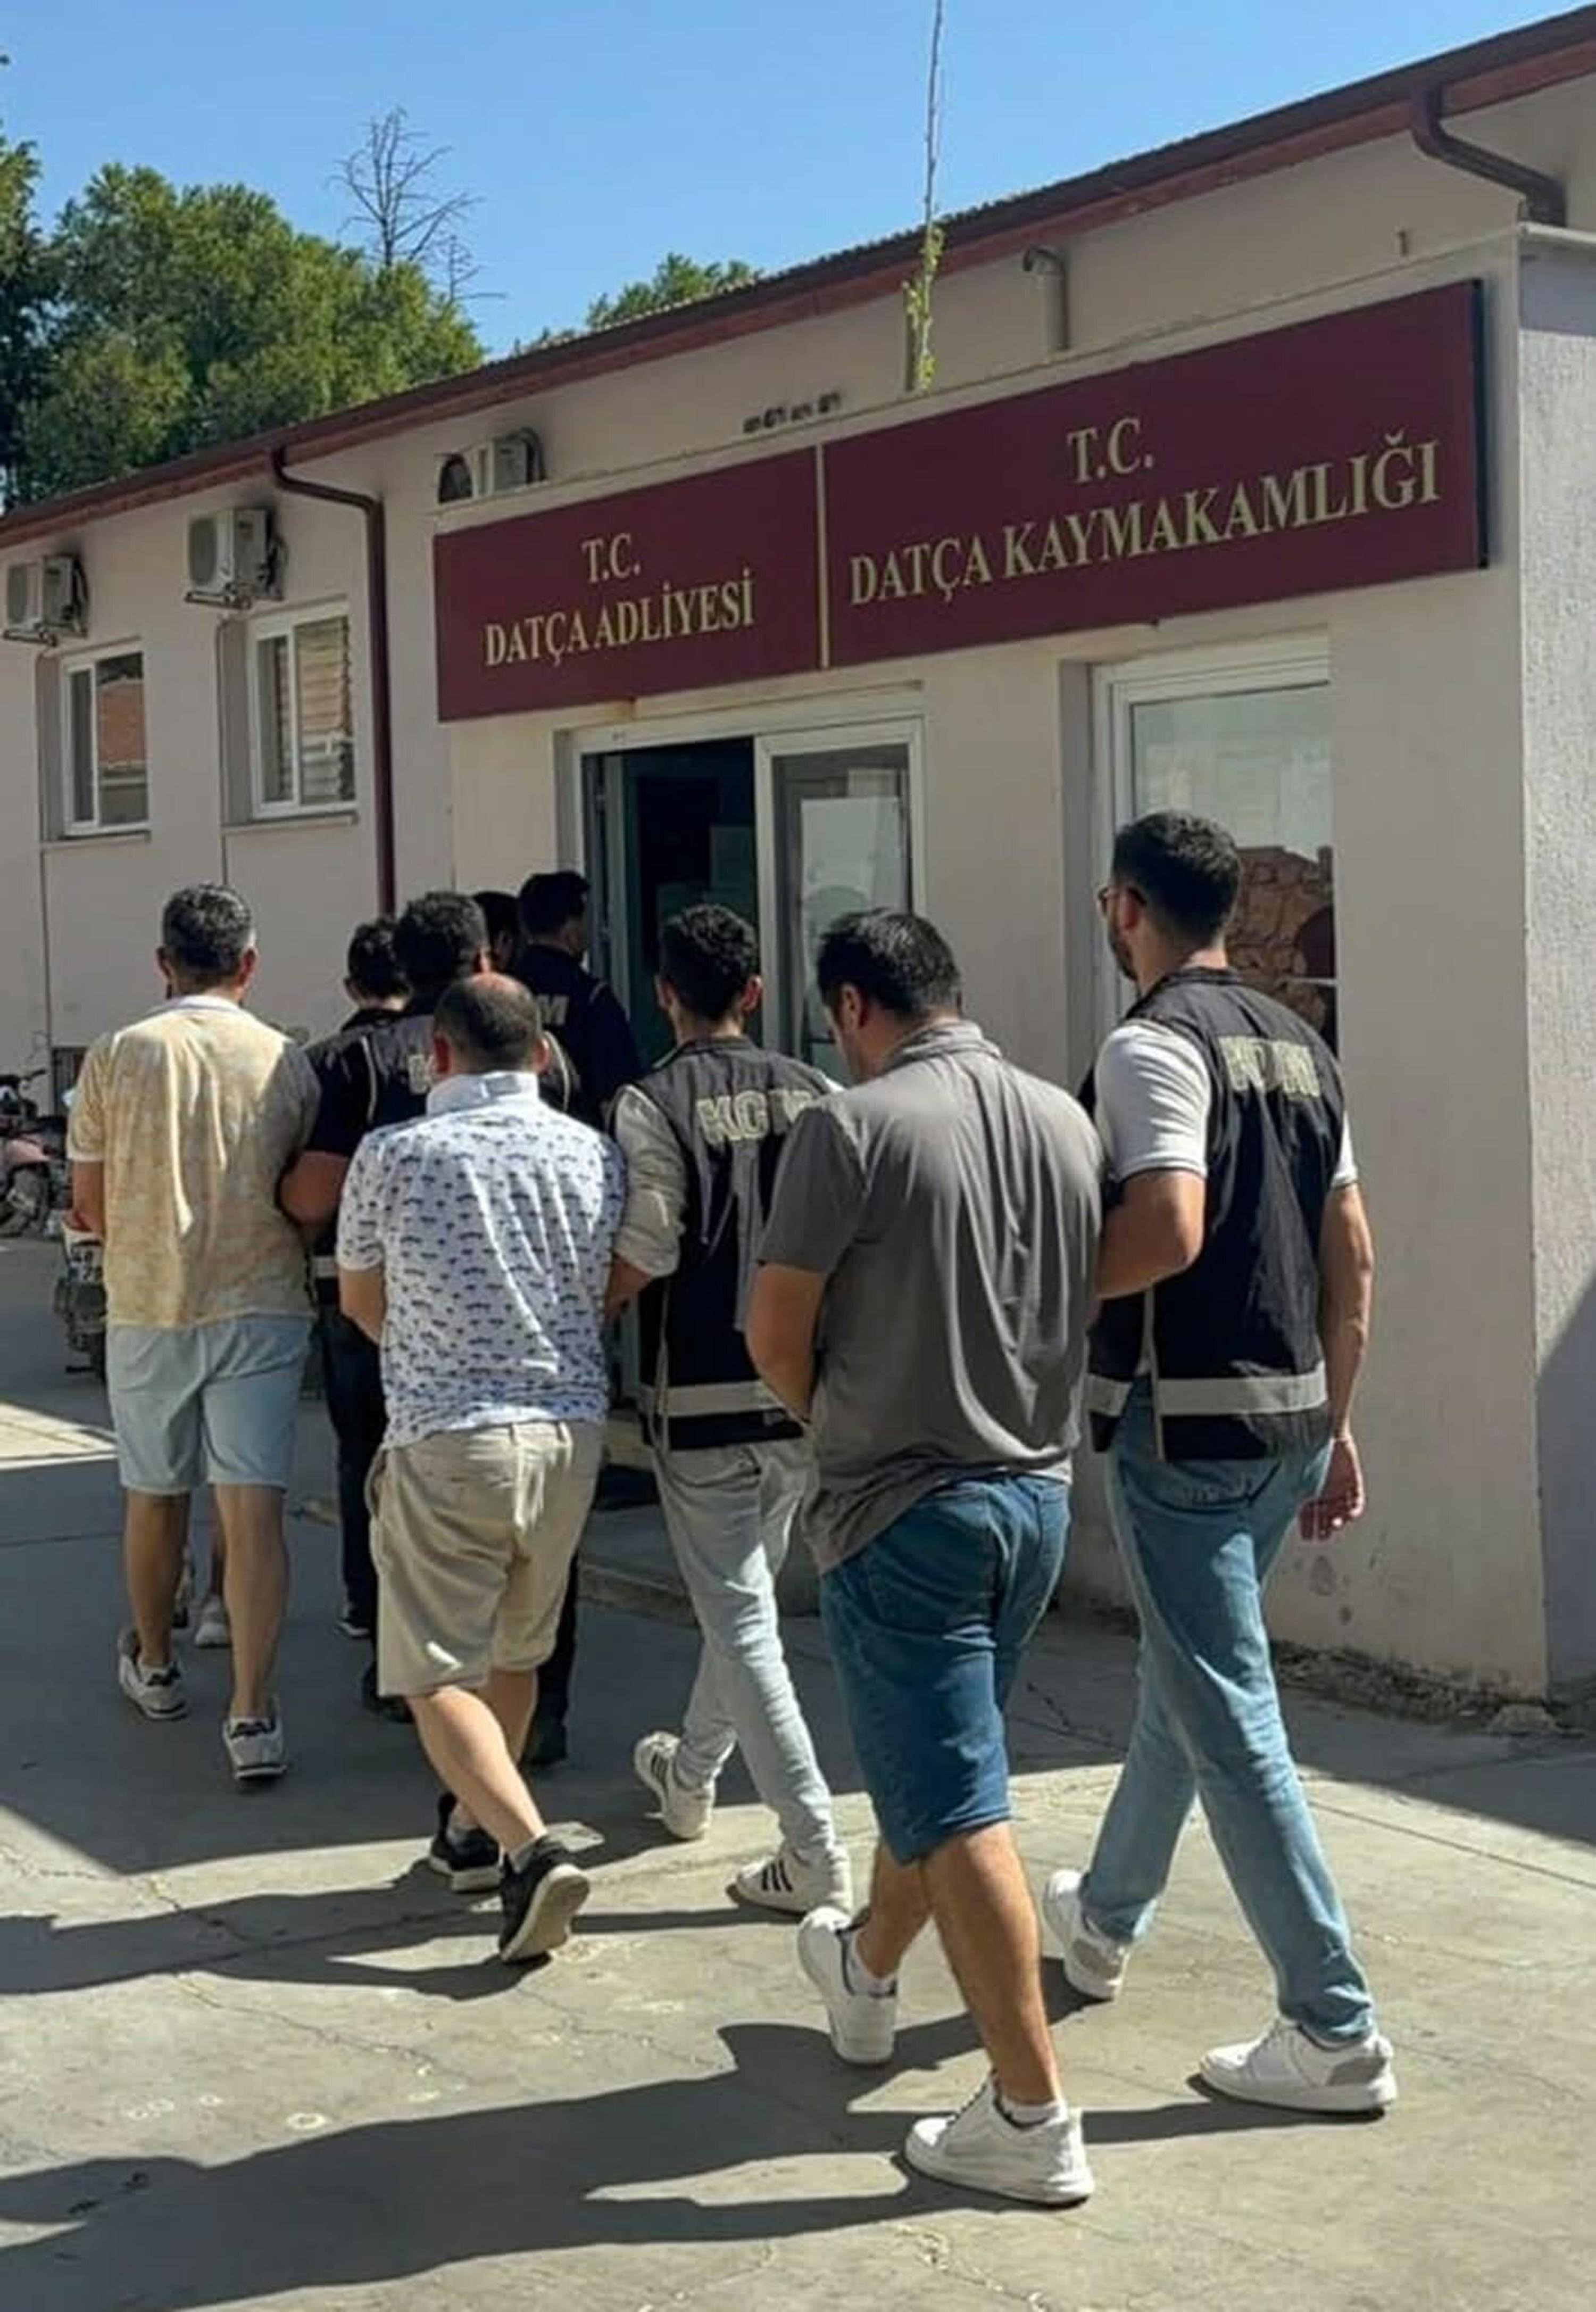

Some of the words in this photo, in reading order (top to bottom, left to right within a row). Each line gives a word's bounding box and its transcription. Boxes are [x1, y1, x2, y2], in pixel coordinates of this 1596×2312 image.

[1066, 418, 1154, 483] T.C.
[582, 533, 641, 583] T.C.
[850, 534, 993, 605] DATÇA
[1003, 430, 1440, 578] KAYMAKAMLIĞI
[484, 610, 589, 667] DATÇA
[594, 567, 755, 648] ADLİYESİ
